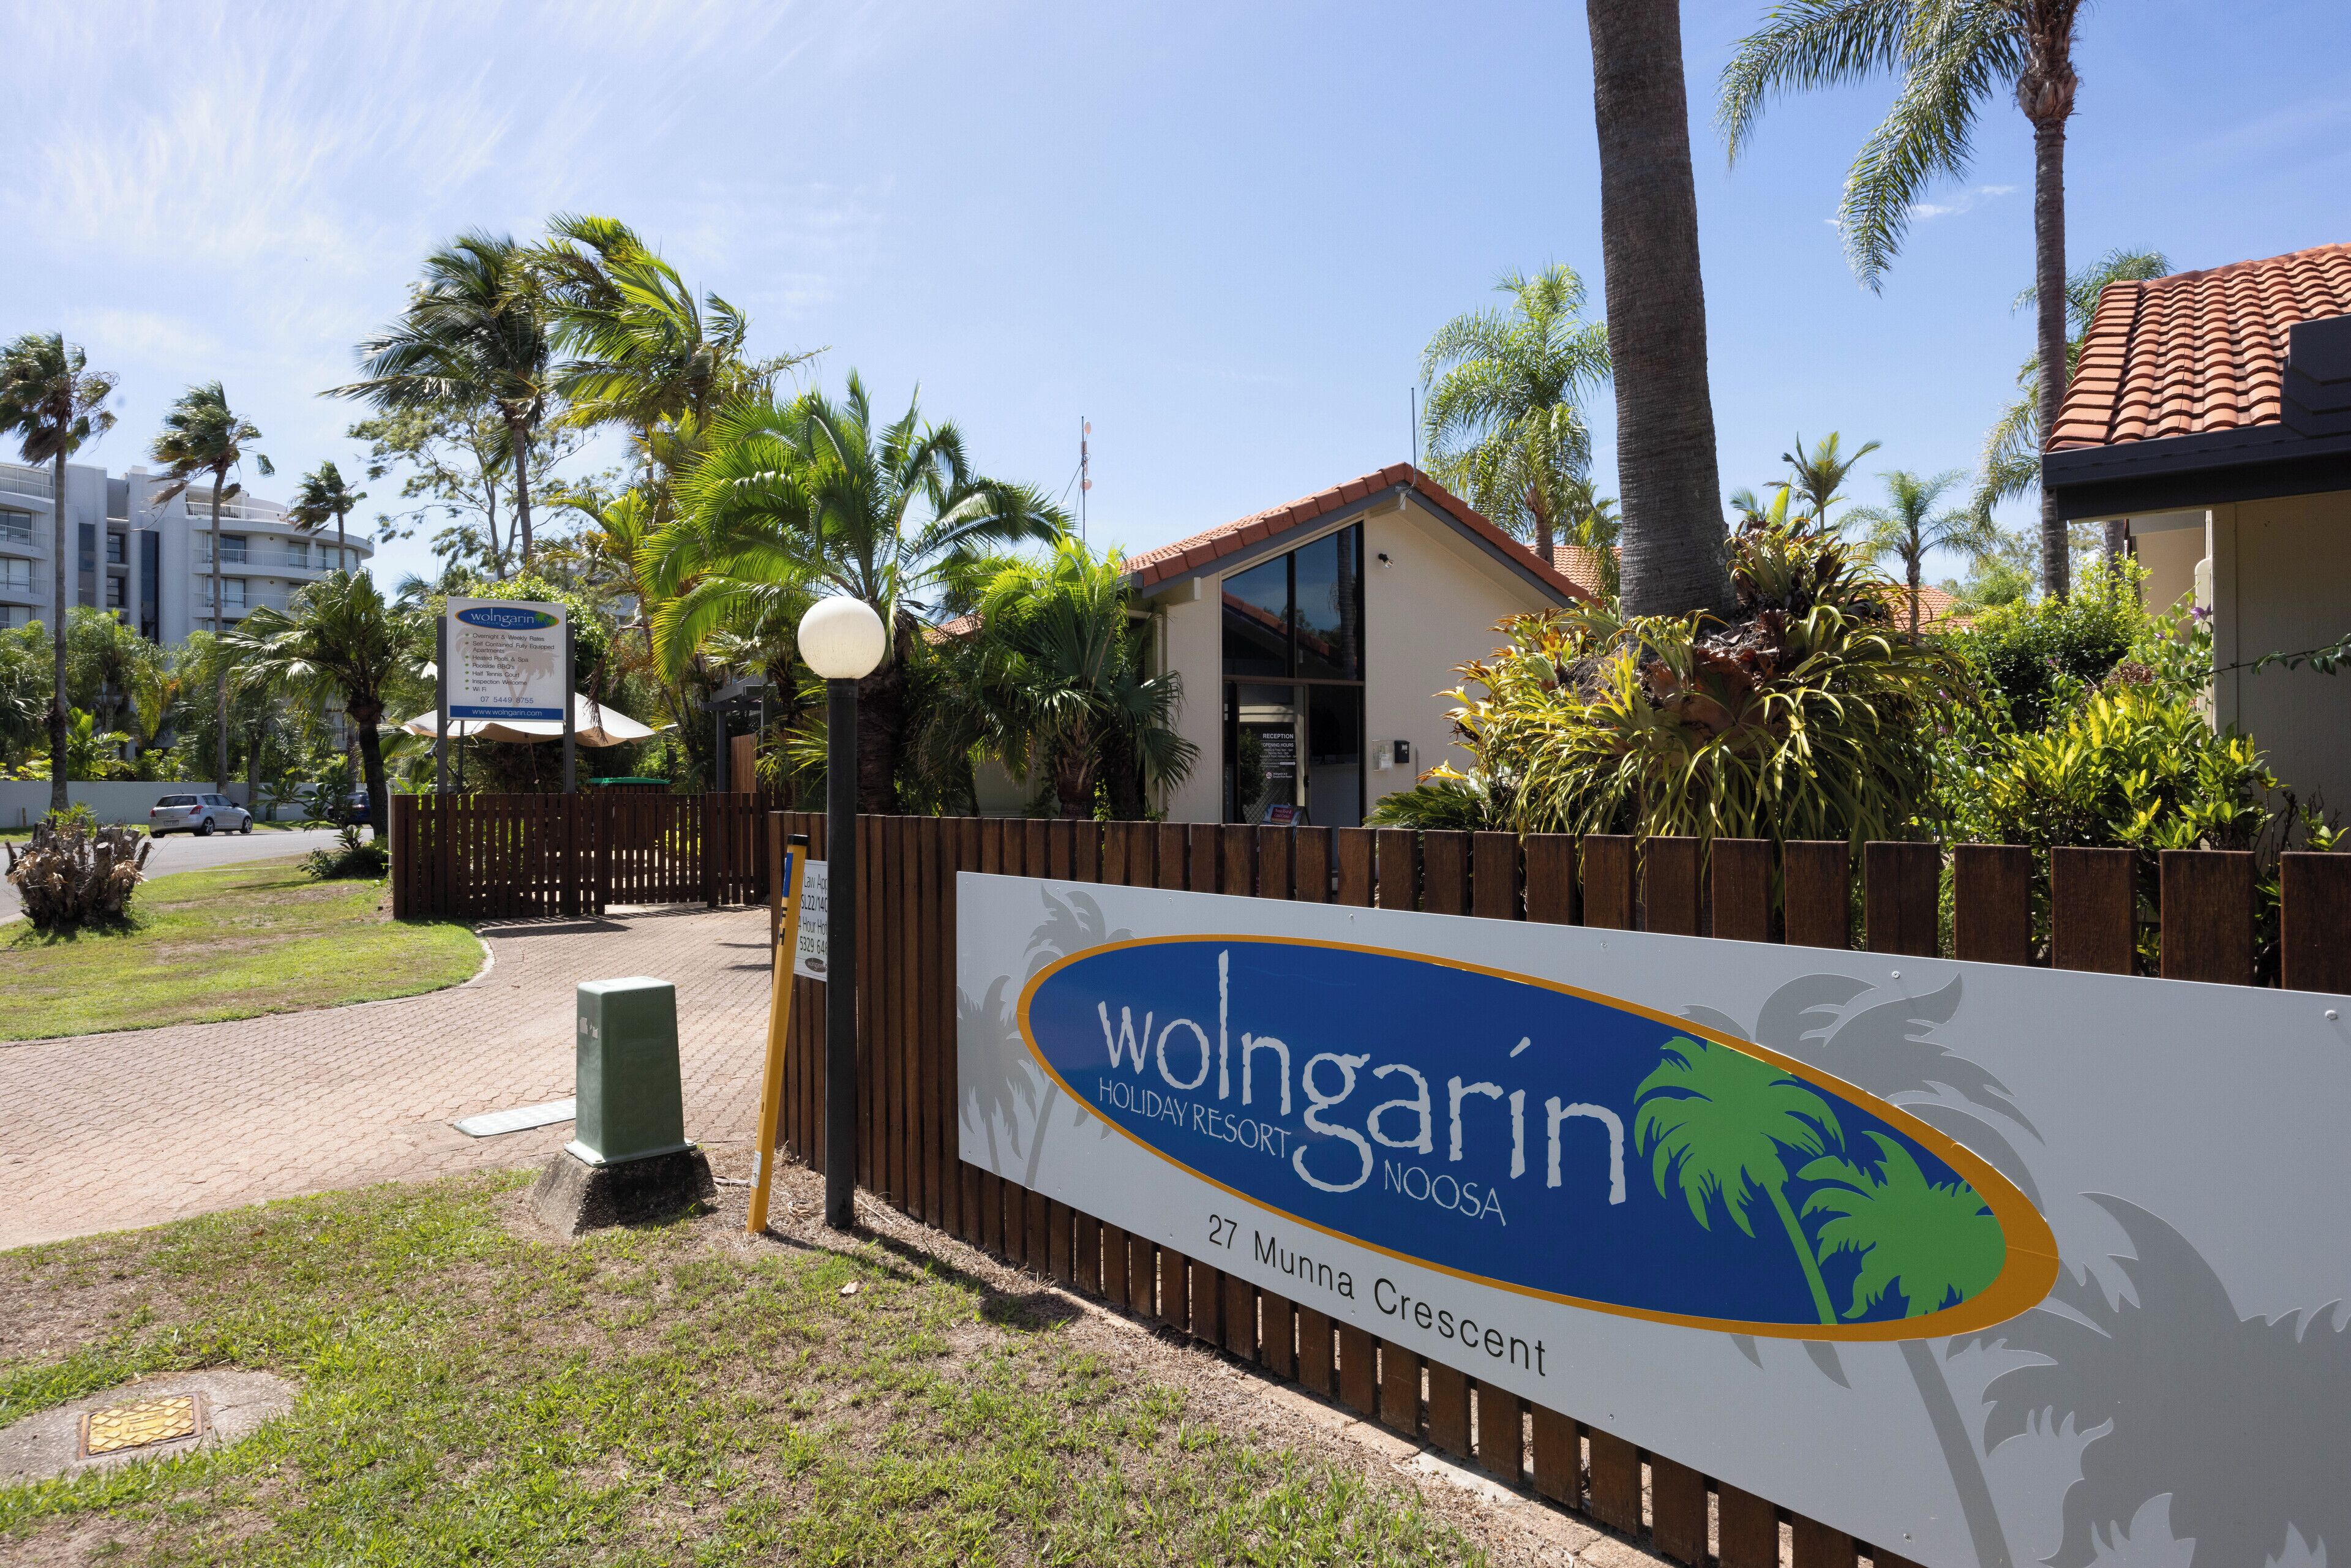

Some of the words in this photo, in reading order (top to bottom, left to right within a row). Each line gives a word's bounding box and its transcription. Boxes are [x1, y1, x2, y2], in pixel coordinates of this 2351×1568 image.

[804, 872, 816, 888] Law
[817, 873, 828, 895] App
[800, 936, 814, 953] 5329
[803, 917, 816, 933] Hour
[817, 918, 828, 936] Hot
[1100, 1077, 1188, 1127] HOLIDAY
[1193, 1104, 1292, 1158] RESORT
[1384, 1160, 1506, 1226] NOOSA
[1209, 1214, 1237, 1250] 27
[1254, 1230, 1355, 1300] Munna
[1374, 1278, 1546, 1377] Crescent
